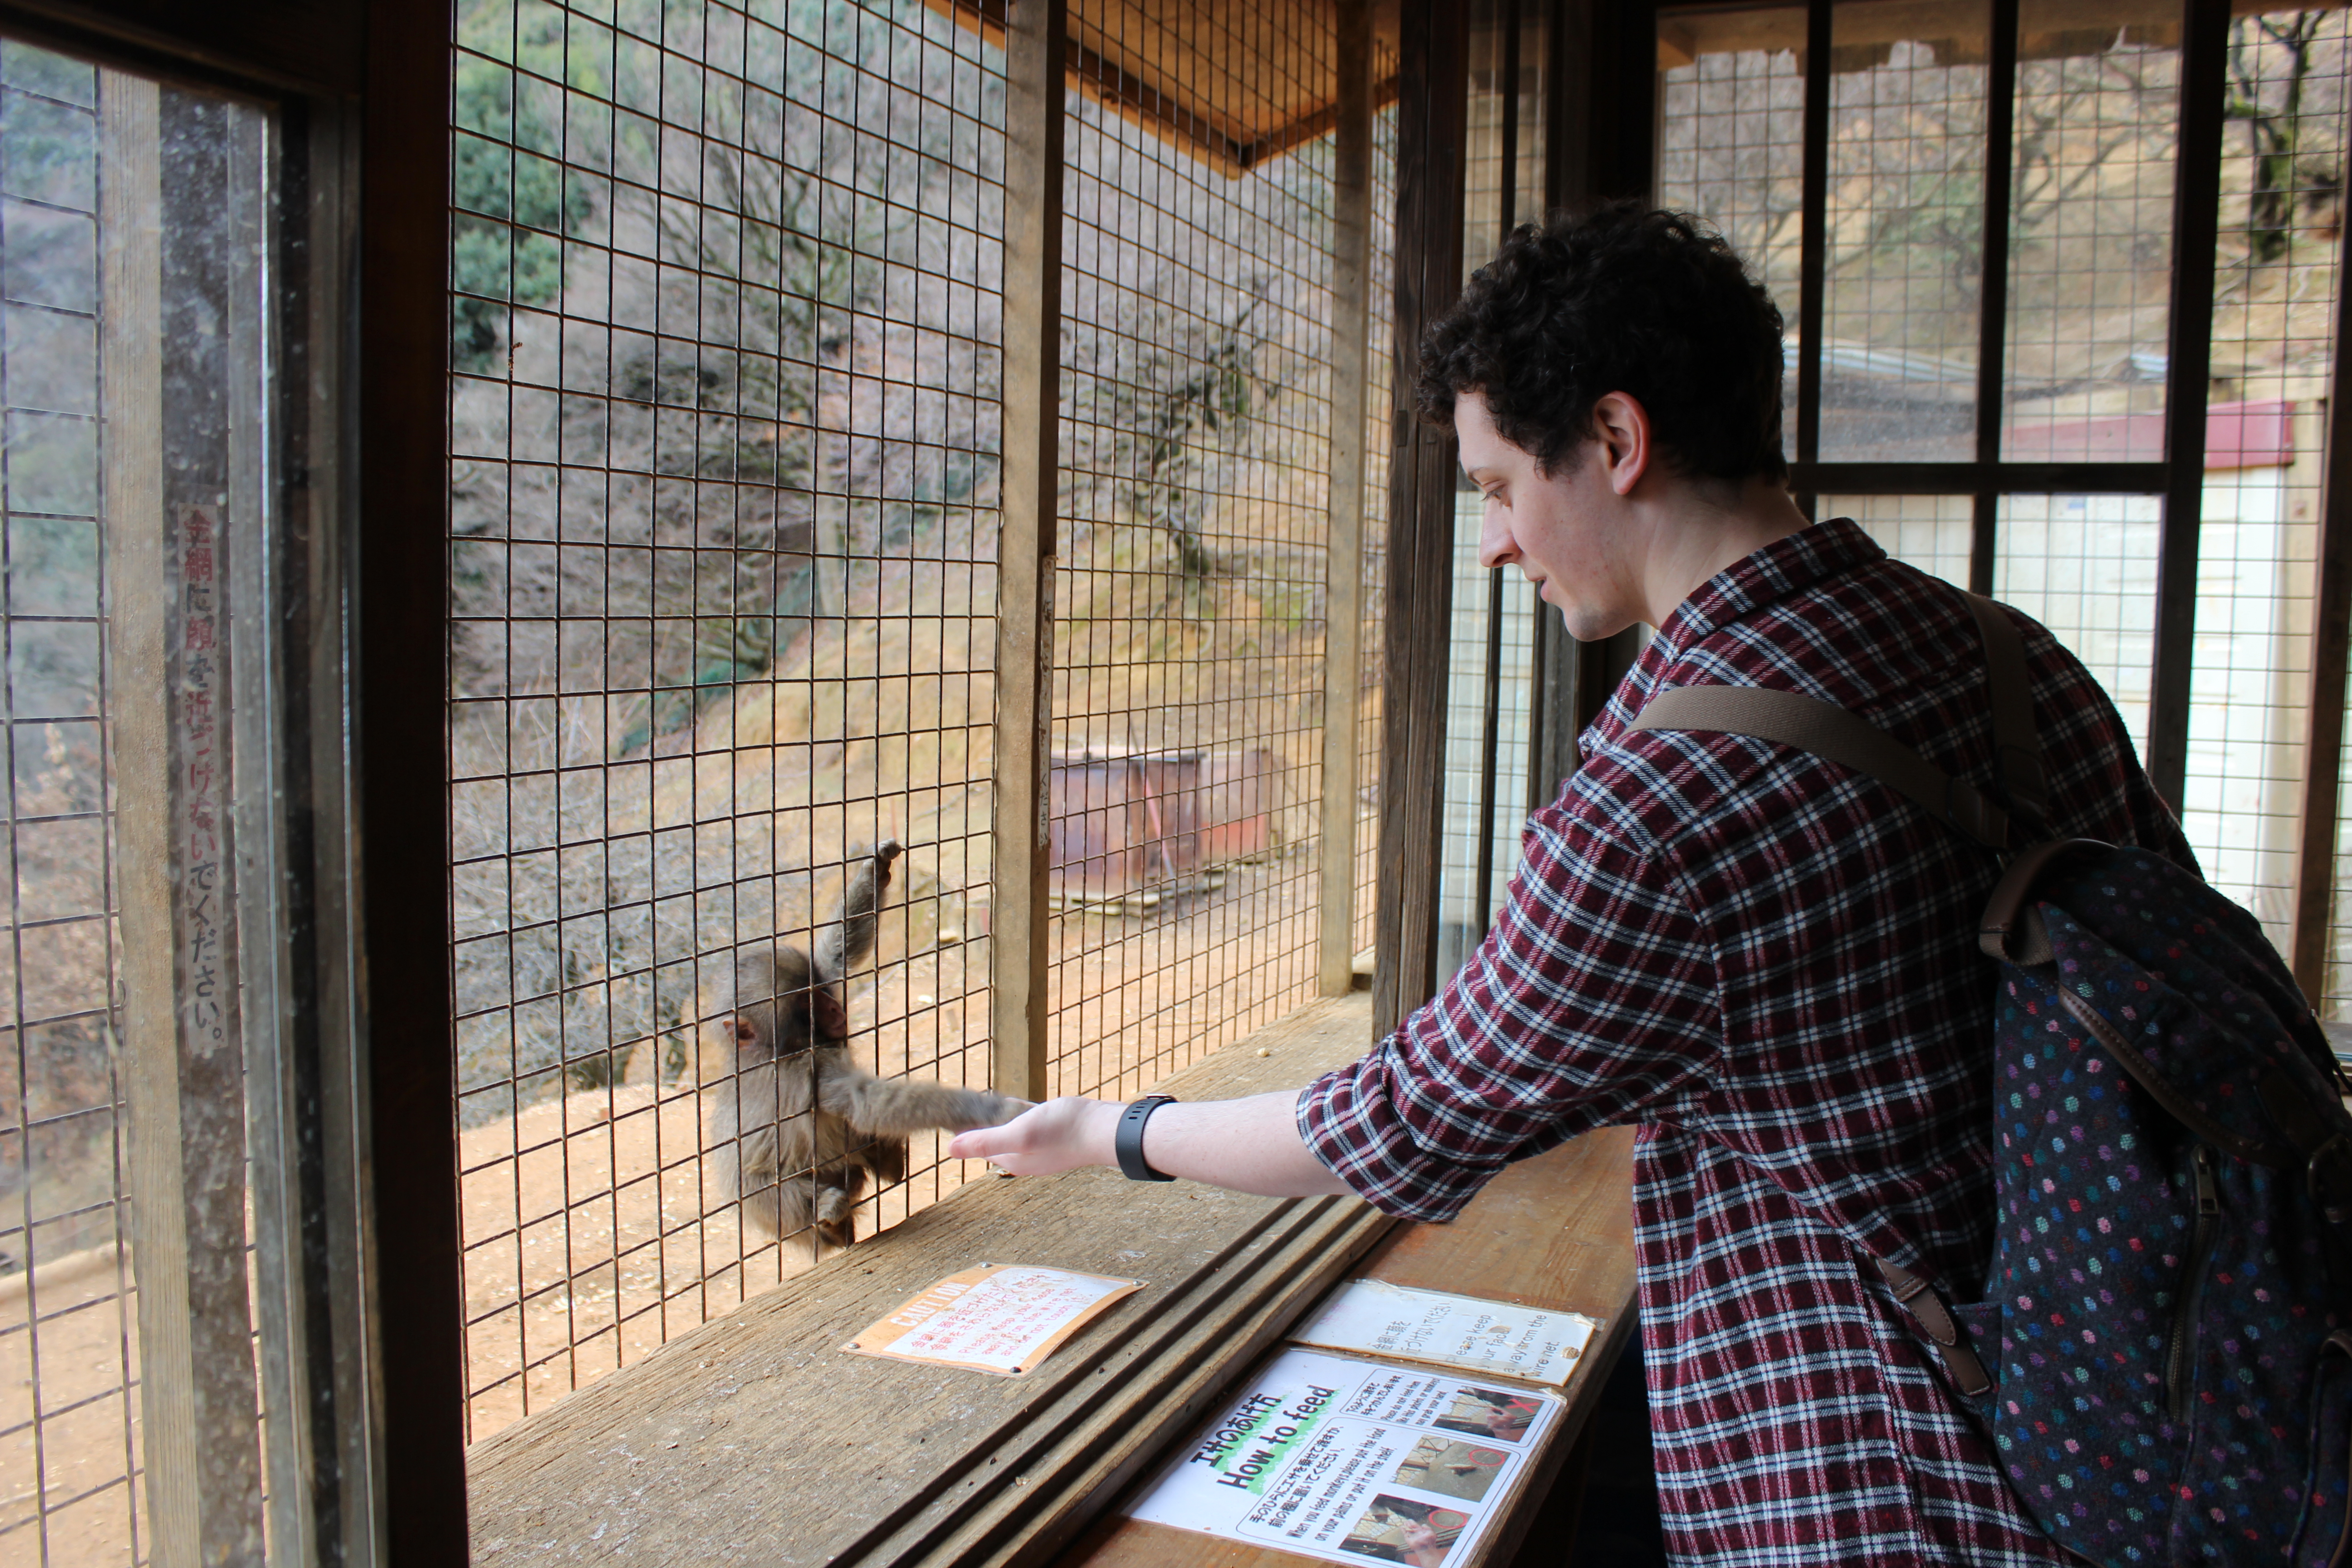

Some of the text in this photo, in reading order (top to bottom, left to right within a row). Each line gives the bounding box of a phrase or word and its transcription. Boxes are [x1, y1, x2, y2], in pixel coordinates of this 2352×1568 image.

[890, 1282, 971, 1326] CAUTION
[958, 1333, 995, 1353] Please
[1013, 1303, 1034, 1315] your
[1465, 1314, 1492, 1334] keep
[1528, 1314, 1547, 1328] the
[981, 1341, 1005, 1355] away
[1021, 1313, 1042, 1322] the
[1001, 1345, 1020, 1356] and
[1030, 1323, 1049, 1333] not
[1044, 1304, 1073, 1320] touch
[1372, 1321, 1411, 1349] 金網に顔を
[1543, 1341, 1560, 1357] net.
[1400, 1388, 1414, 1397] feed
[1397, 1396, 1407, 1405] not
[1190, 1393, 1282, 1467] エサのあげ方
[1216, 1385, 1335, 1489] How to feed
[1366, 1427, 1387, 1440] food
[1358, 1440, 1377, 1449] the
[1355, 1448, 1369, 1459] put
[1365, 1460, 1385, 1470] the
[1351, 1483, 1367, 1494] put
[1309, 1497, 1331, 1511] feed
[1345, 1493, 1357, 1501] or
[1303, 1511, 1320, 1522] you
[1333, 1501, 1352, 1519] palms
[1285, 1523, 1311, 1538] When
[1321, 1518, 1339, 1533] your
[1314, 1533, 1329, 1541] on
